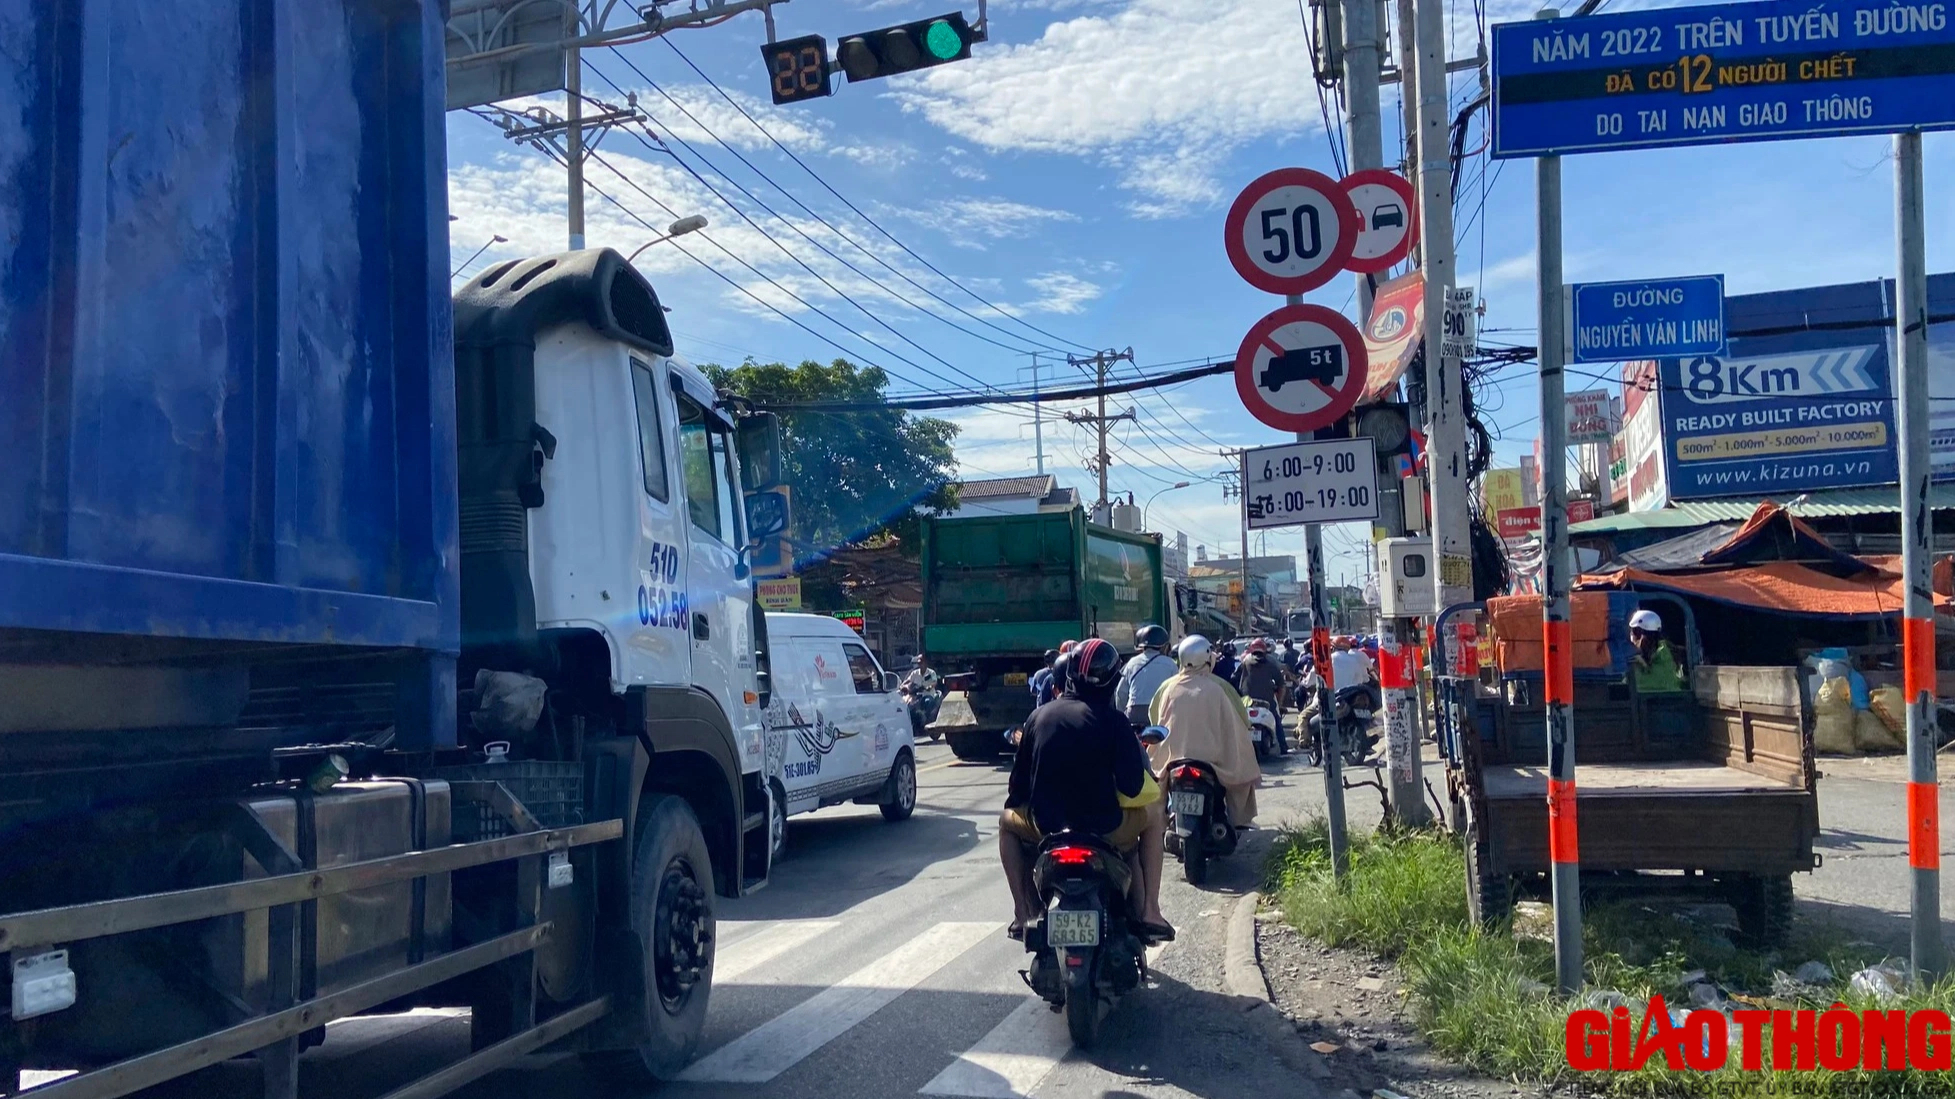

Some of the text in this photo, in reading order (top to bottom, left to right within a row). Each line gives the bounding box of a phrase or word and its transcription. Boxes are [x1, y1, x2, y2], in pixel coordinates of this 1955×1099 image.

[1533, 0, 1946, 63] NĂM 2022 TRÊN TUYẾN ĐƯỜNG
[1606, 51, 1857, 93] ĐÃ CÓ 12 NGƯỜI CHẾT
[1597, 93, 1873, 136] DO TAI NẠN GIAO THÔNG
[1261, 204, 1322, 263] 50
[1613, 285, 1684, 308] ĐƯỜNG
[1646, 317, 1677, 346] VĂN
[1682, 319, 1719, 344] LINH
[1676, 400, 1884, 432] READY BUILT FACTORY
[1697, 461, 1871, 485] www.kizuna.vn
[650, 542, 678, 584] 51D
[638, 585, 688, 630] 052.58
